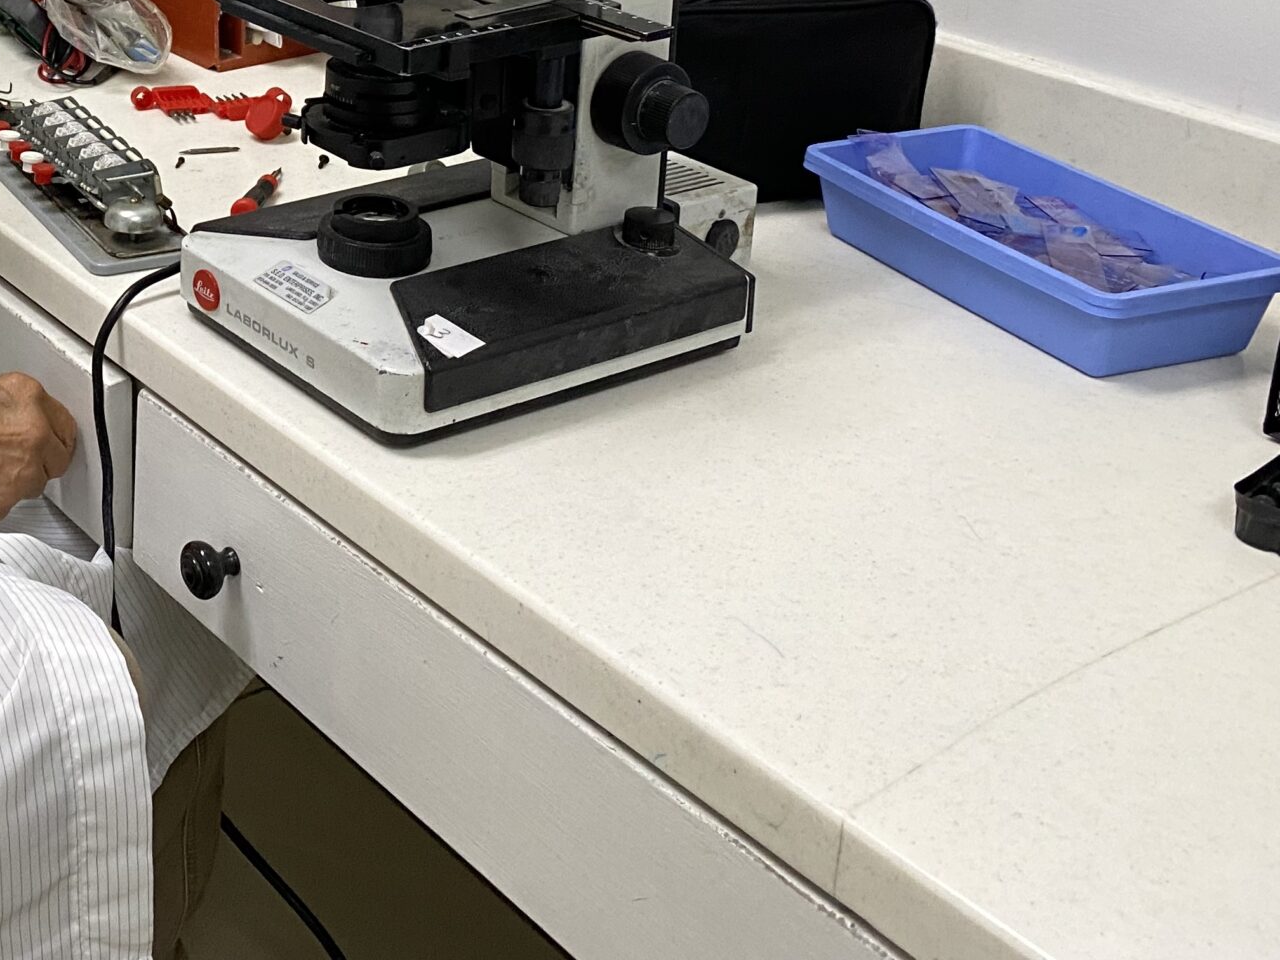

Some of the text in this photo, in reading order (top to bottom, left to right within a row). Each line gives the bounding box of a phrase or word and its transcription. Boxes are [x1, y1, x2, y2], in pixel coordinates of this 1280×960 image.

[194, 280, 215, 300] Leitz
[226, 303, 316, 369] LABORLUX S
